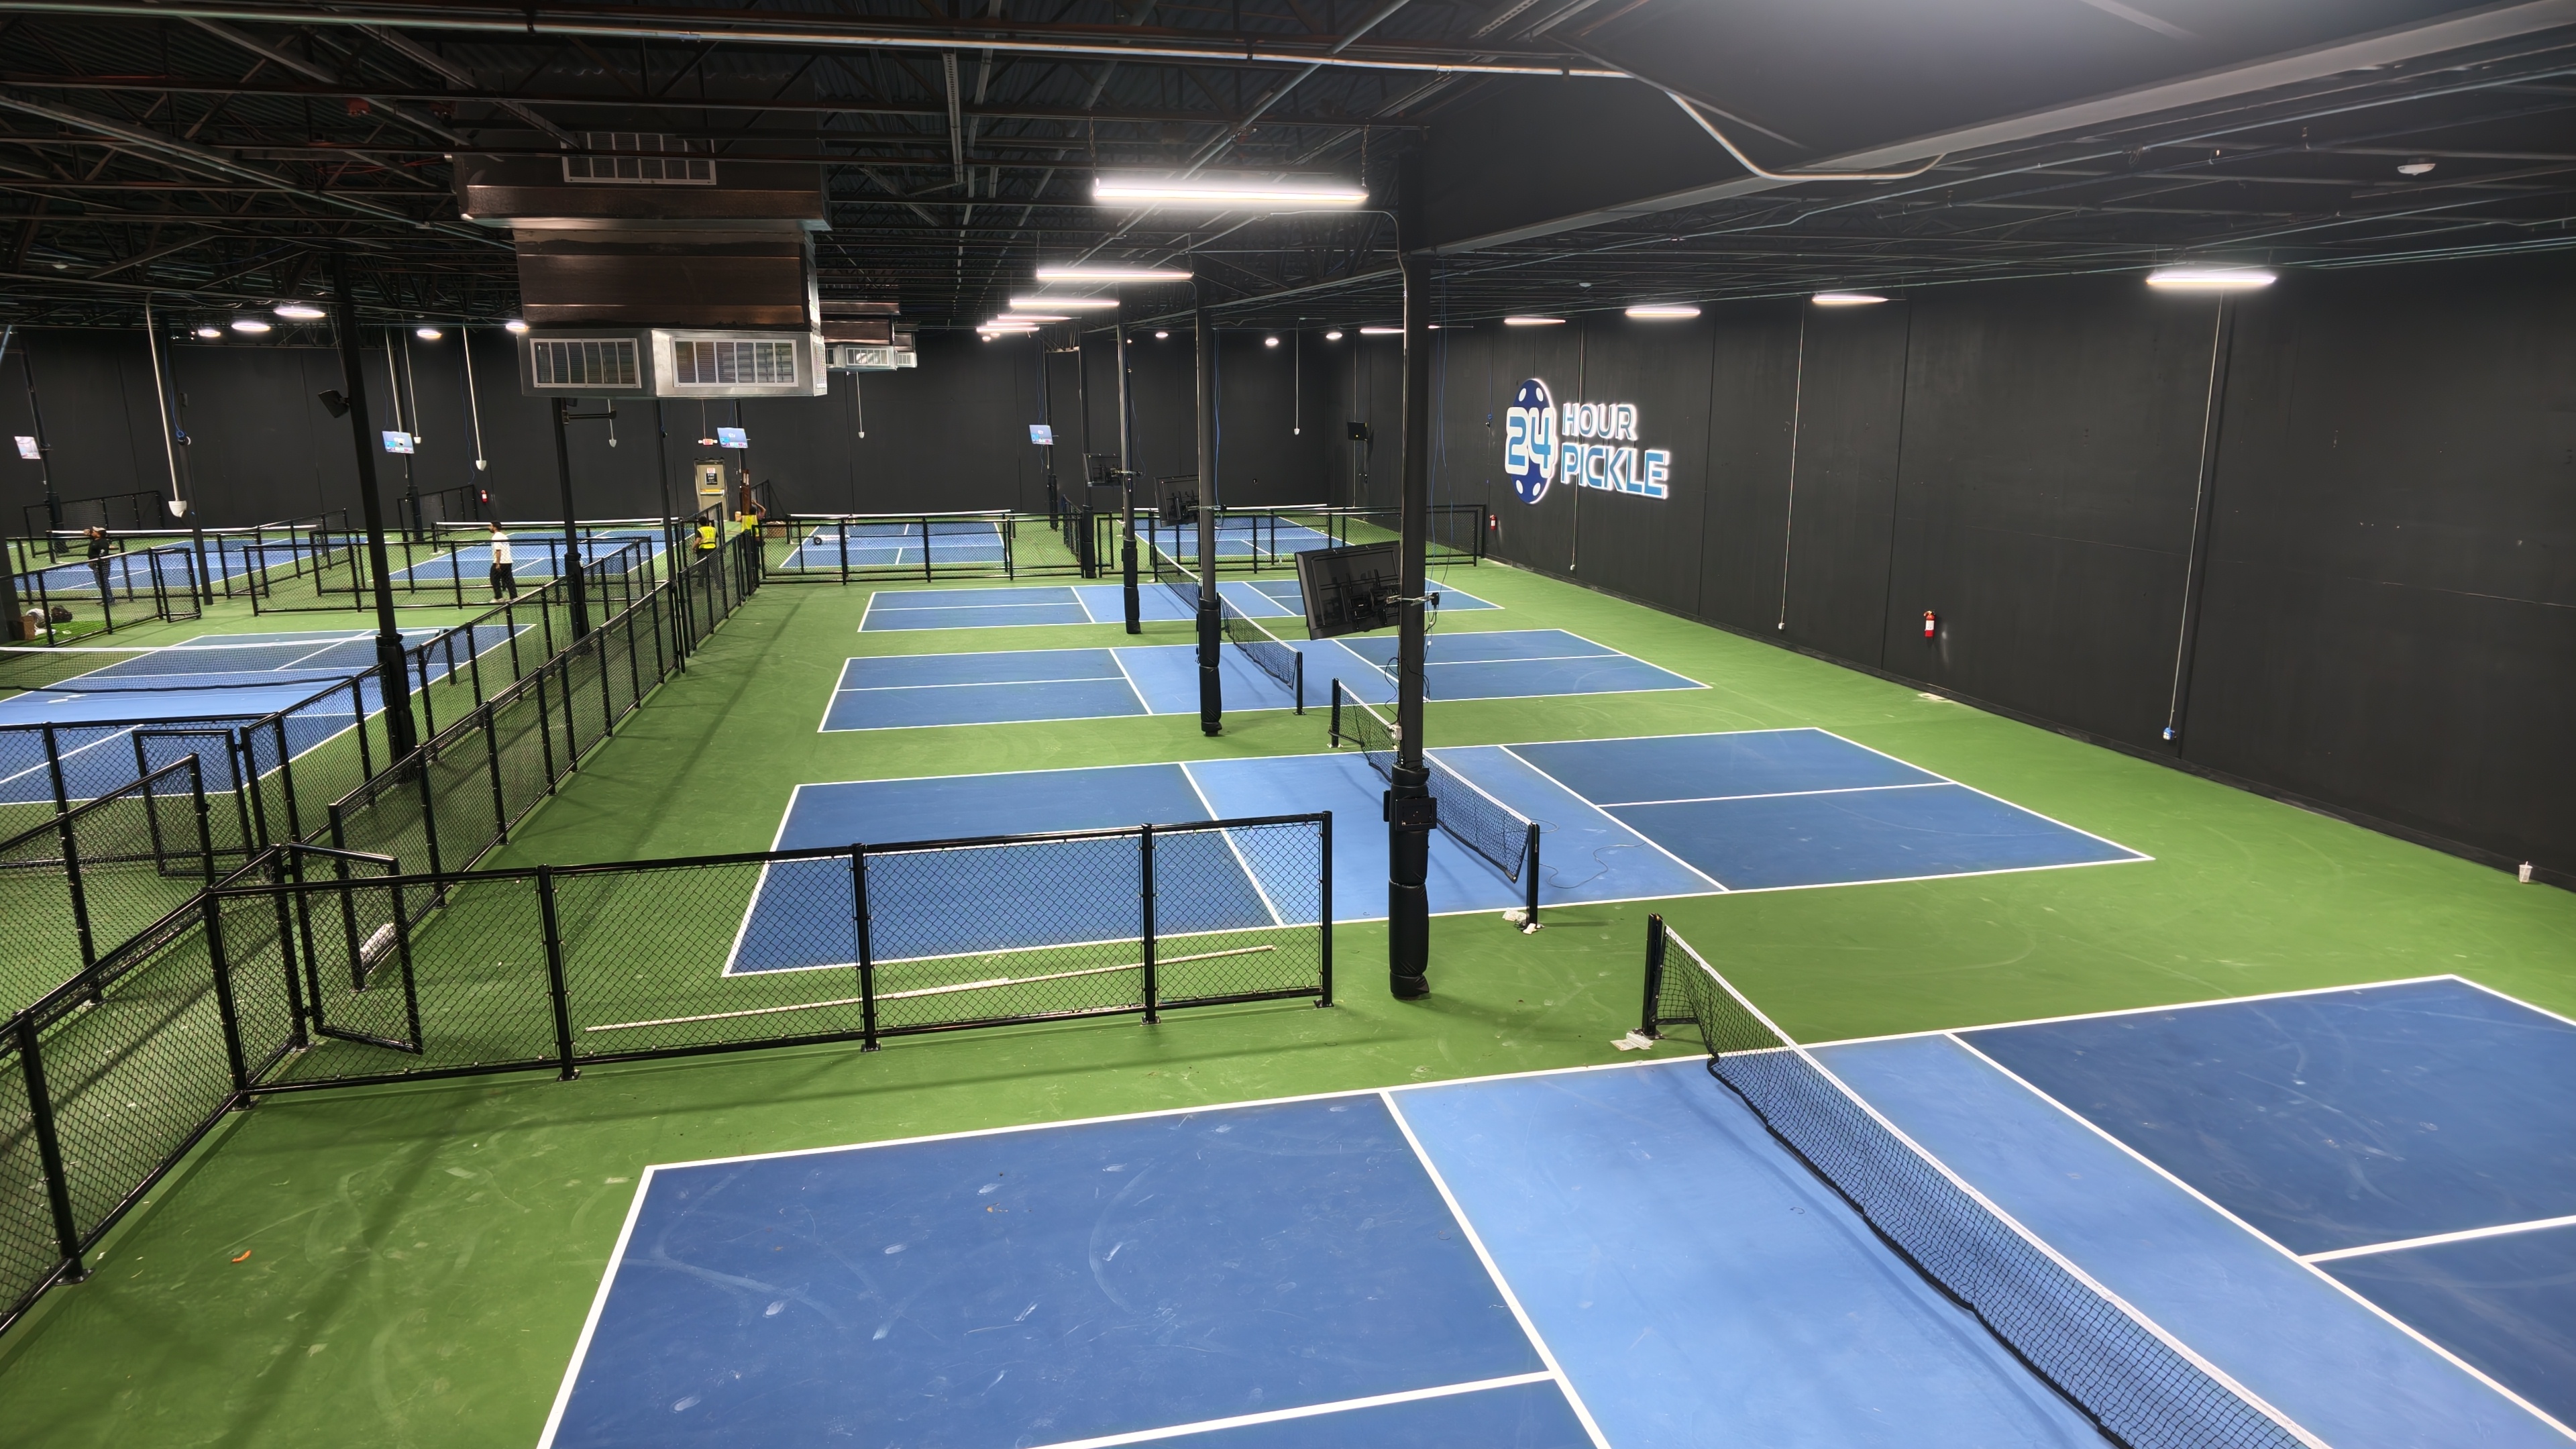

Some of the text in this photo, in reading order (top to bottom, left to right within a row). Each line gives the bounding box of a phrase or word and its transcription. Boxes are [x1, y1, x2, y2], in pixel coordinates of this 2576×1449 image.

[1505, 407, 1555, 477] 24
[1562, 403, 1637, 441] HOUR
[1560, 443, 1669, 499] PICKLE
